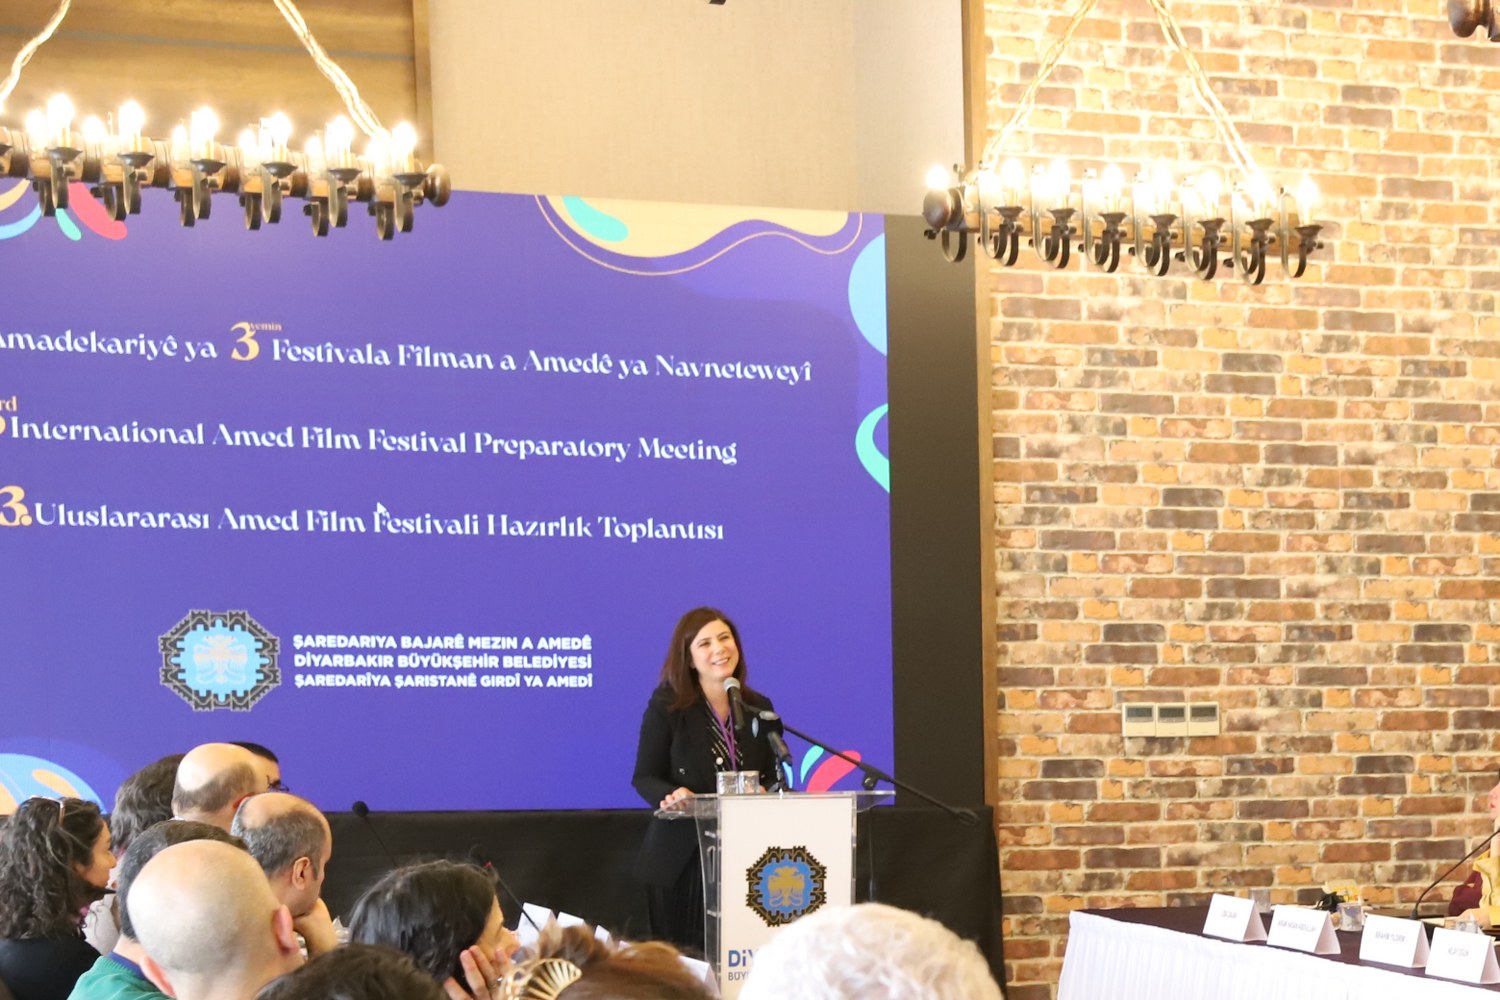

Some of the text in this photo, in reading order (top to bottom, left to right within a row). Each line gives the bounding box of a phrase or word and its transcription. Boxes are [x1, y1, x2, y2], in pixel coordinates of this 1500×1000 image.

[184, 341, 218, 362] ya
[230, 321, 260, 361] 3
[272, 338, 391, 366] Festîvala
[500, 354, 517, 371] a
[523, 350, 613, 374] Amedê
[618, 357, 649, 380] ya
[656, 354, 812, 386] Navneteweyî
[11, 415, 205, 445] International
[212, 423, 294, 448] Amed
[301, 426, 362, 450] Film
[368, 428, 467, 453] Festival
[474, 431, 631, 463] Preparatory
[637, 437, 738, 466] Meeting
[34, 502, 210, 529] Uluslararası
[217, 507, 300, 531] Amed
[306, 509, 367, 533] Film
[373, 511, 479, 535] Festivali
[487, 514, 593, 538] Hazırlık
[597, 516, 724, 543] Toplantısı
[401, 633, 465, 649] BAJARÊ
[468, 636, 517, 649] MEZIN
[521, 637, 533, 649] A
[537, 634, 592, 650] AMEDÊ
[294, 652, 592, 670] DİYARBAKIR BÜYÜKŞEHİR BELEDİYESİ
[523, 675, 543, 688] YA
